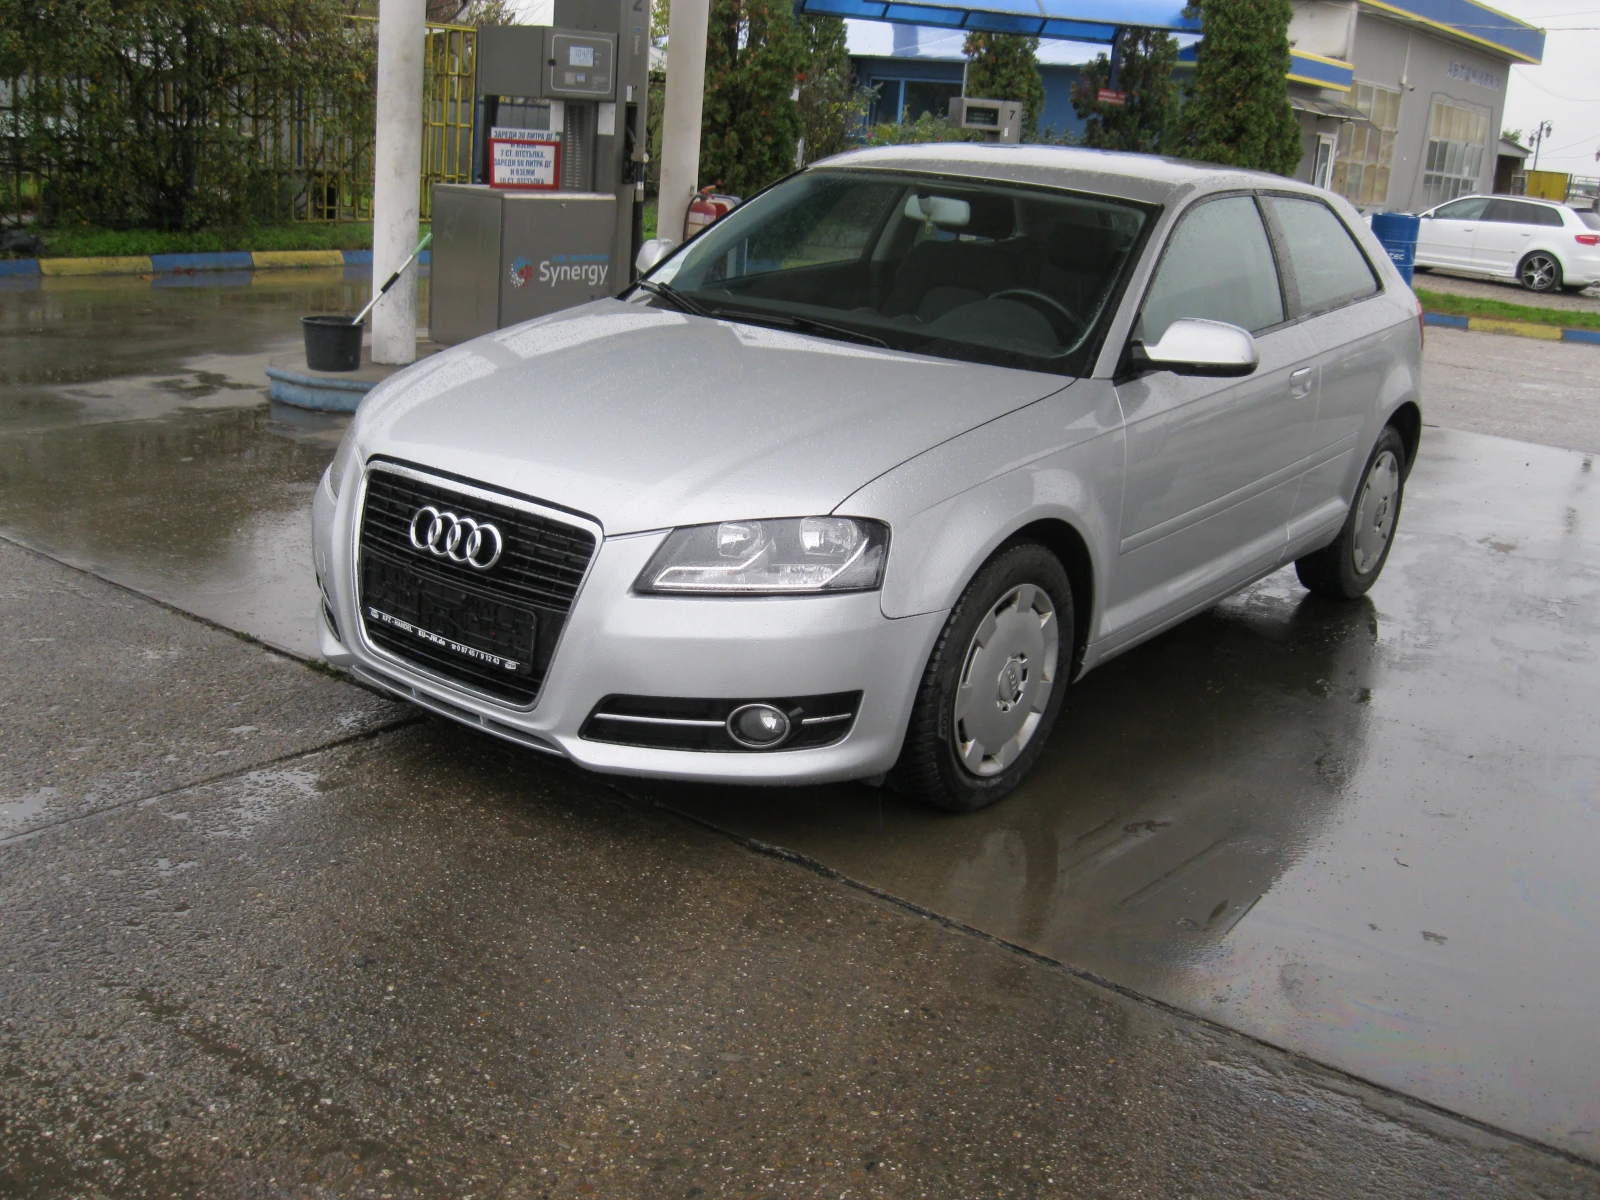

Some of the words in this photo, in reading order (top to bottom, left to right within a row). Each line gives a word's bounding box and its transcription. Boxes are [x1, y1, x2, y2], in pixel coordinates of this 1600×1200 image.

[1009, 110, 1016, 120] 7
[494, 131, 517, 139] ЗАРЕДИ
[527, 132, 544, 140] ЛИТРА
[494, 158, 516, 167] ЗАРЕДИ
[544, 160, 552, 168] ДГ
[1389, 252, 1404, 260] tec
[540, 260, 609, 288] Synergy
[394, 619, 413, 633] HANDEL
